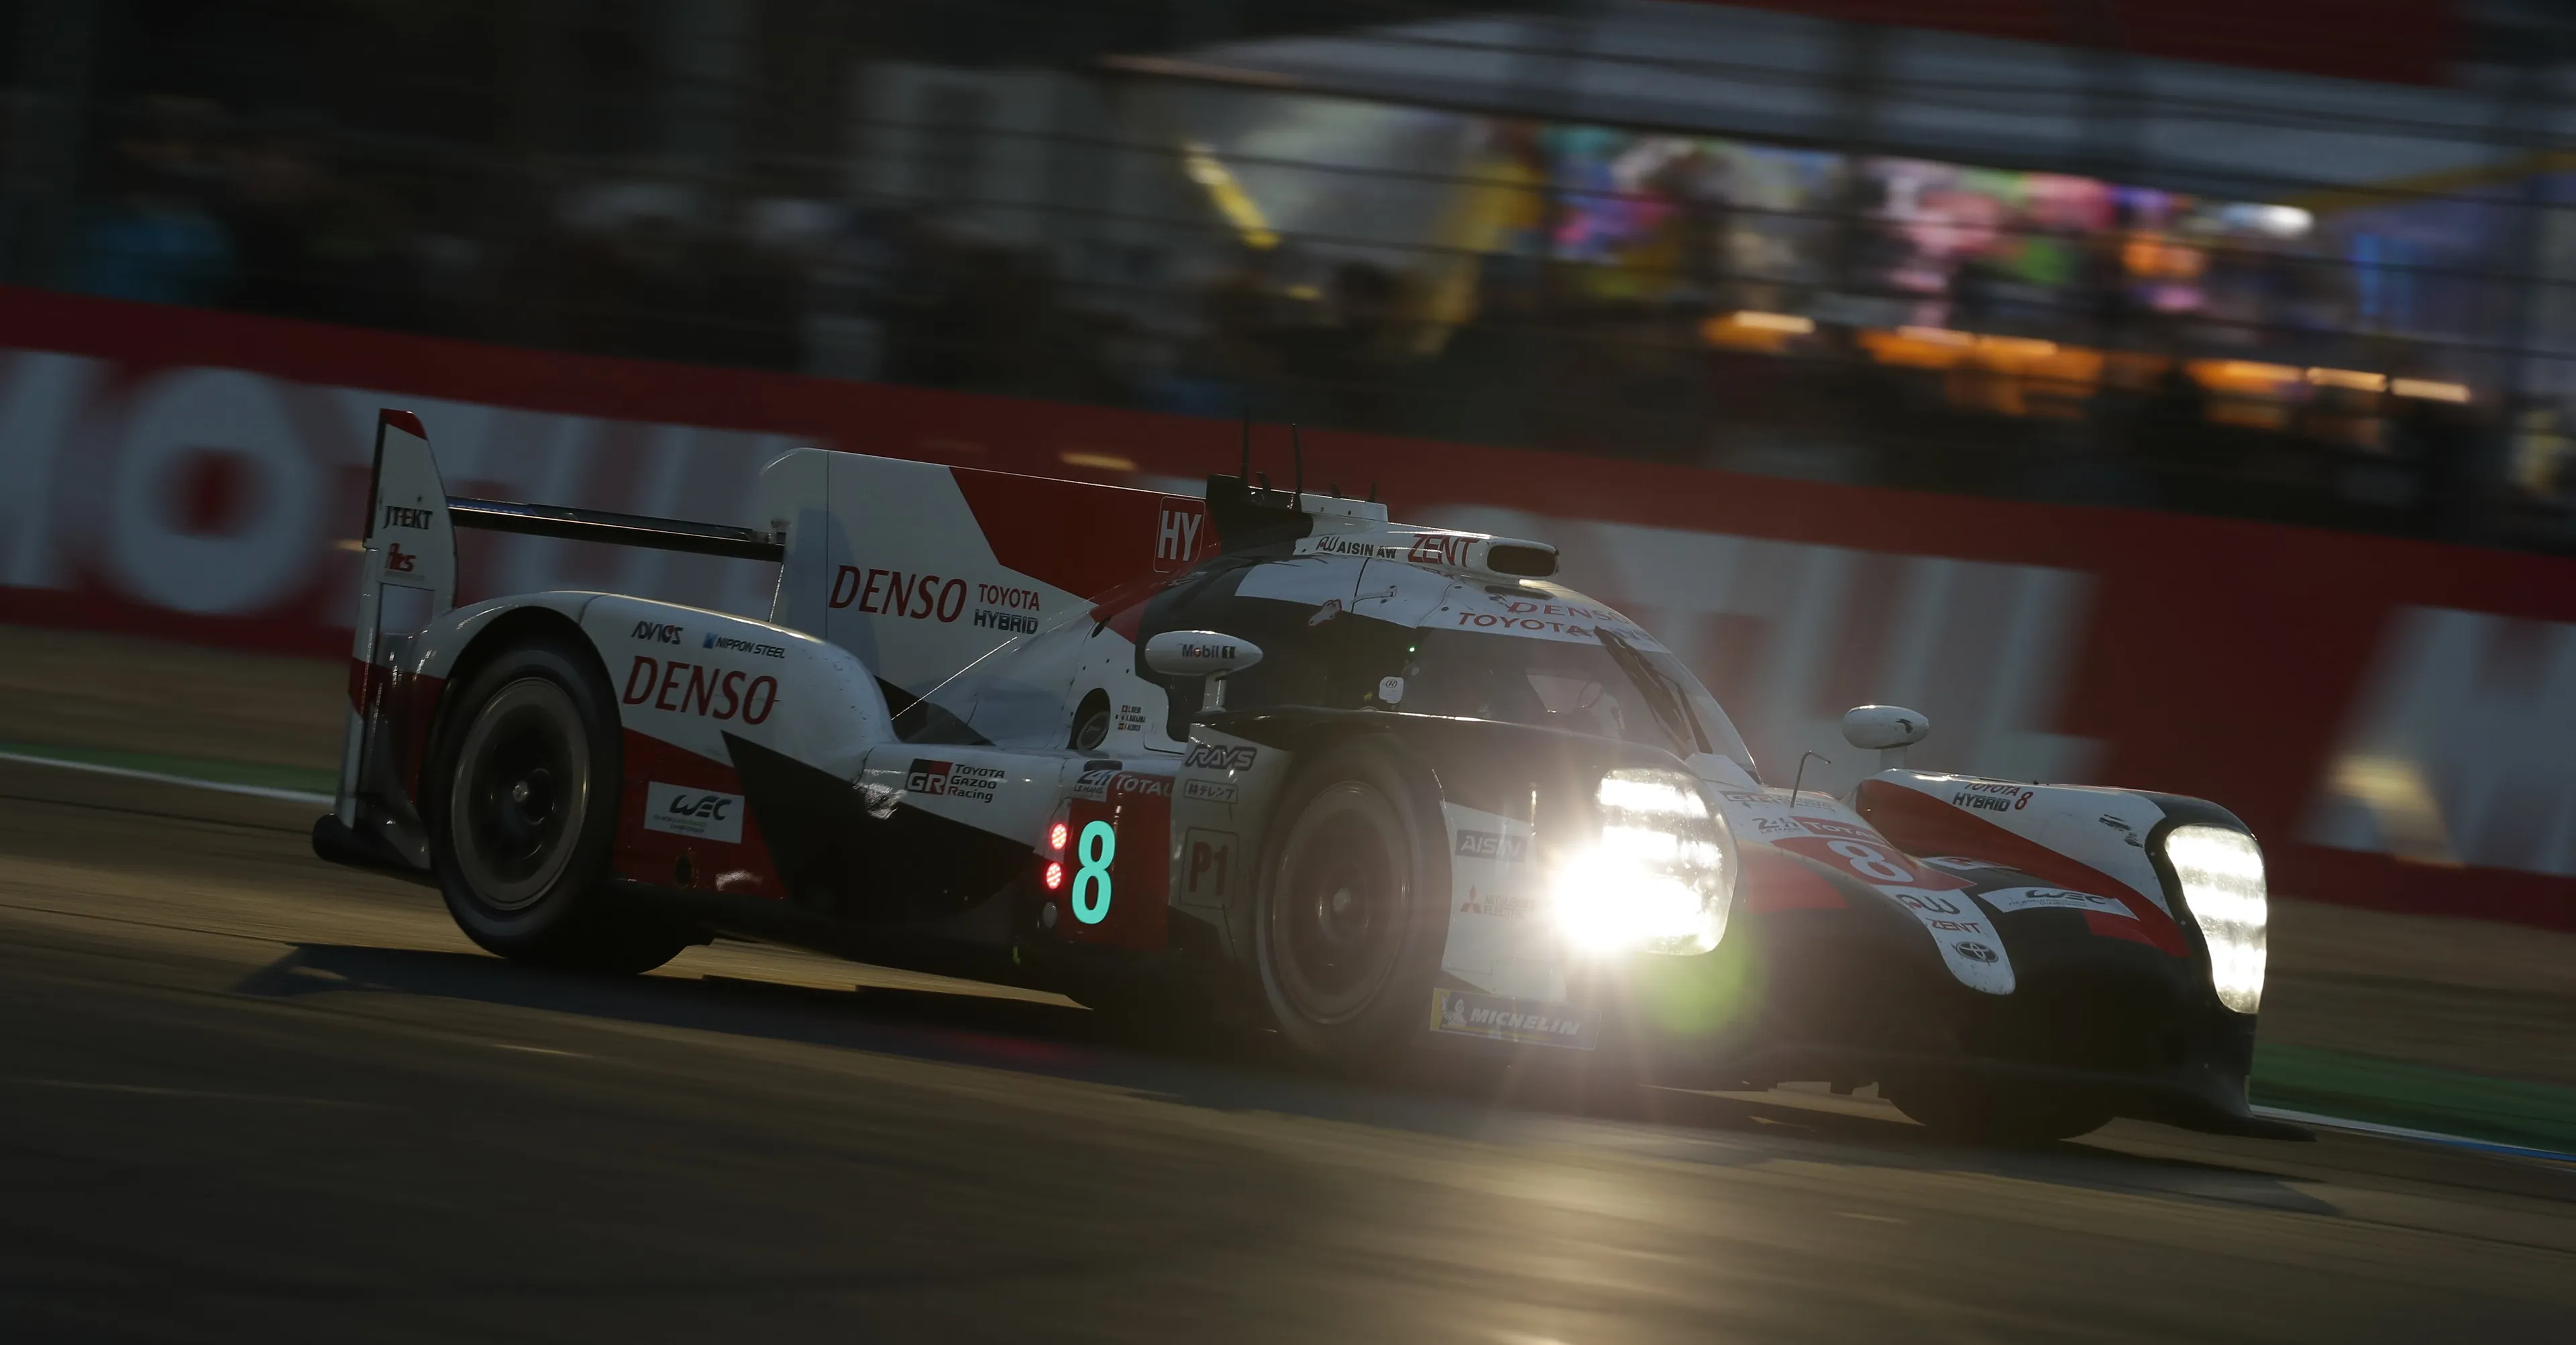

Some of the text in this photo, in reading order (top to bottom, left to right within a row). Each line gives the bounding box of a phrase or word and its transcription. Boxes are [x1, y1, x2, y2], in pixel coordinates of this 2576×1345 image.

[382, 505, 433, 529] JTEKT
[1157, 510, 1202, 561] HY
[1336, 541, 1374, 556] AISIN
[1407, 534, 1479, 568] ZENT
[829, 565, 967, 623] DENSO
[978, 583, 1040, 611] TOYOTA
[973, 608, 1039, 635] HYBRID
[1458, 612, 1594, 637] TOYOTA
[715, 637, 786, 659] NIPPON STEEL
[1182, 643, 1219, 659] Mobil
[623, 655, 777, 724] DENSO
[1185, 744, 1258, 771] RAYS
[951, 775, 998, 789] GAZOO
[955, 763, 1006, 778] TOYOTA
[907, 772, 947, 794] GR
[947, 786, 994, 803] Racing
[1083, 786, 1104, 794] MANS
[1115, 773, 1174, 797] TOTAL
[1964, 782, 2021, 796] TOYOTA
[669, 794, 732, 821] WEC
[1952, 792, 2011, 812] HYBRID
[2014, 790, 2034, 810] 8
[1461, 835, 1521, 857] AISIN
[1071, 820, 1116, 926] 8
[1189, 841, 1229, 896] P1
[1827, 840, 1914, 883] 8
[2025, 889, 2105, 905] WEC
[1926, 918, 1981, 934] ZENT
[1470, 1008, 1581, 1036] MICHELIN
